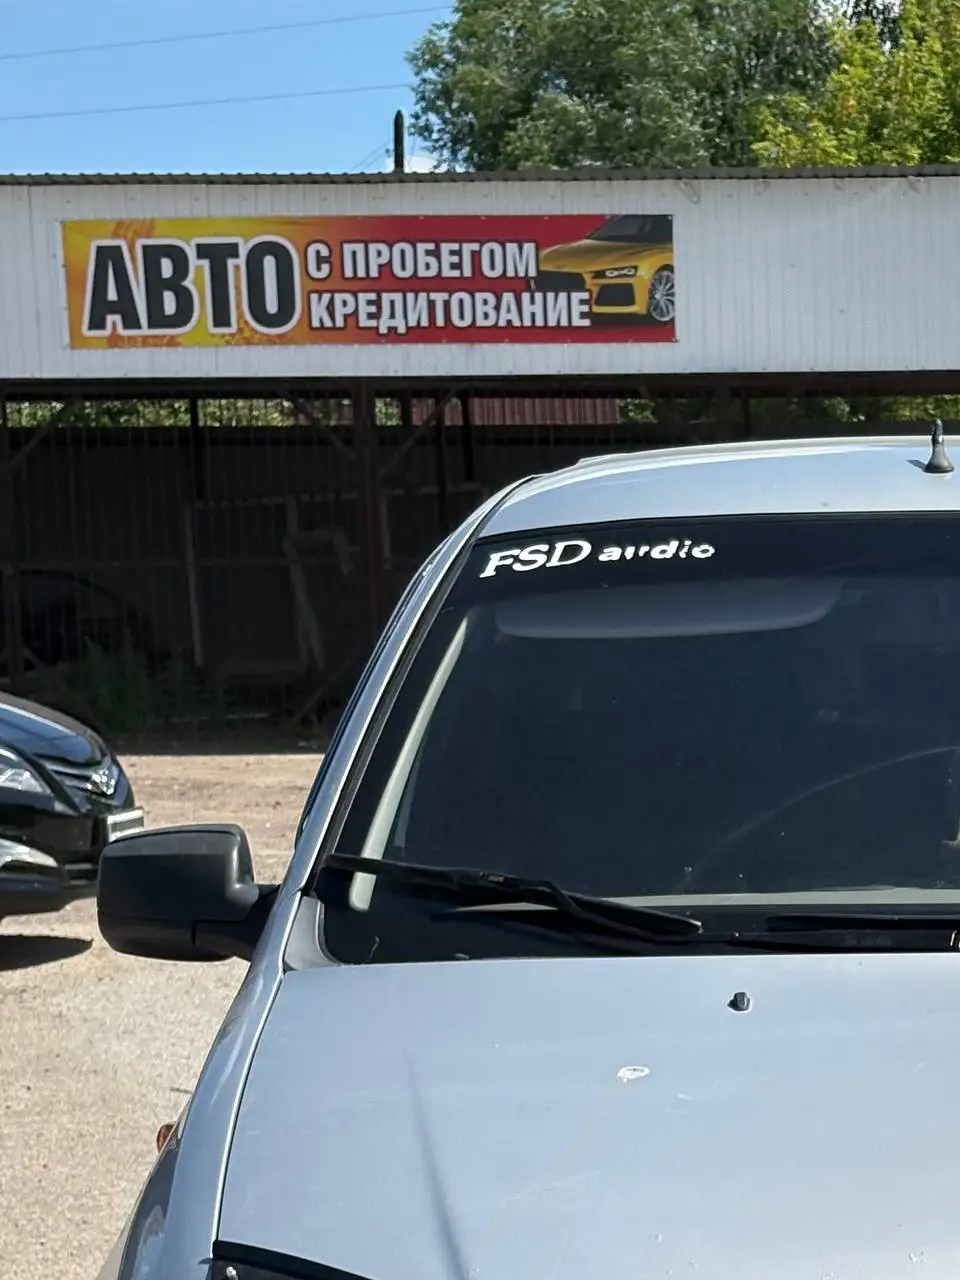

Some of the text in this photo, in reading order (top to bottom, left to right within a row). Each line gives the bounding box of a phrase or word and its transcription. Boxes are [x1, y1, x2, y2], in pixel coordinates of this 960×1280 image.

[306, 241, 537, 279] С ПРОБЕГОМ
[85, 239, 300, 335] АВТО
[309, 290, 592, 334] КРЕДИТОВАНИЕ
[479, 540, 592, 579] FSD
